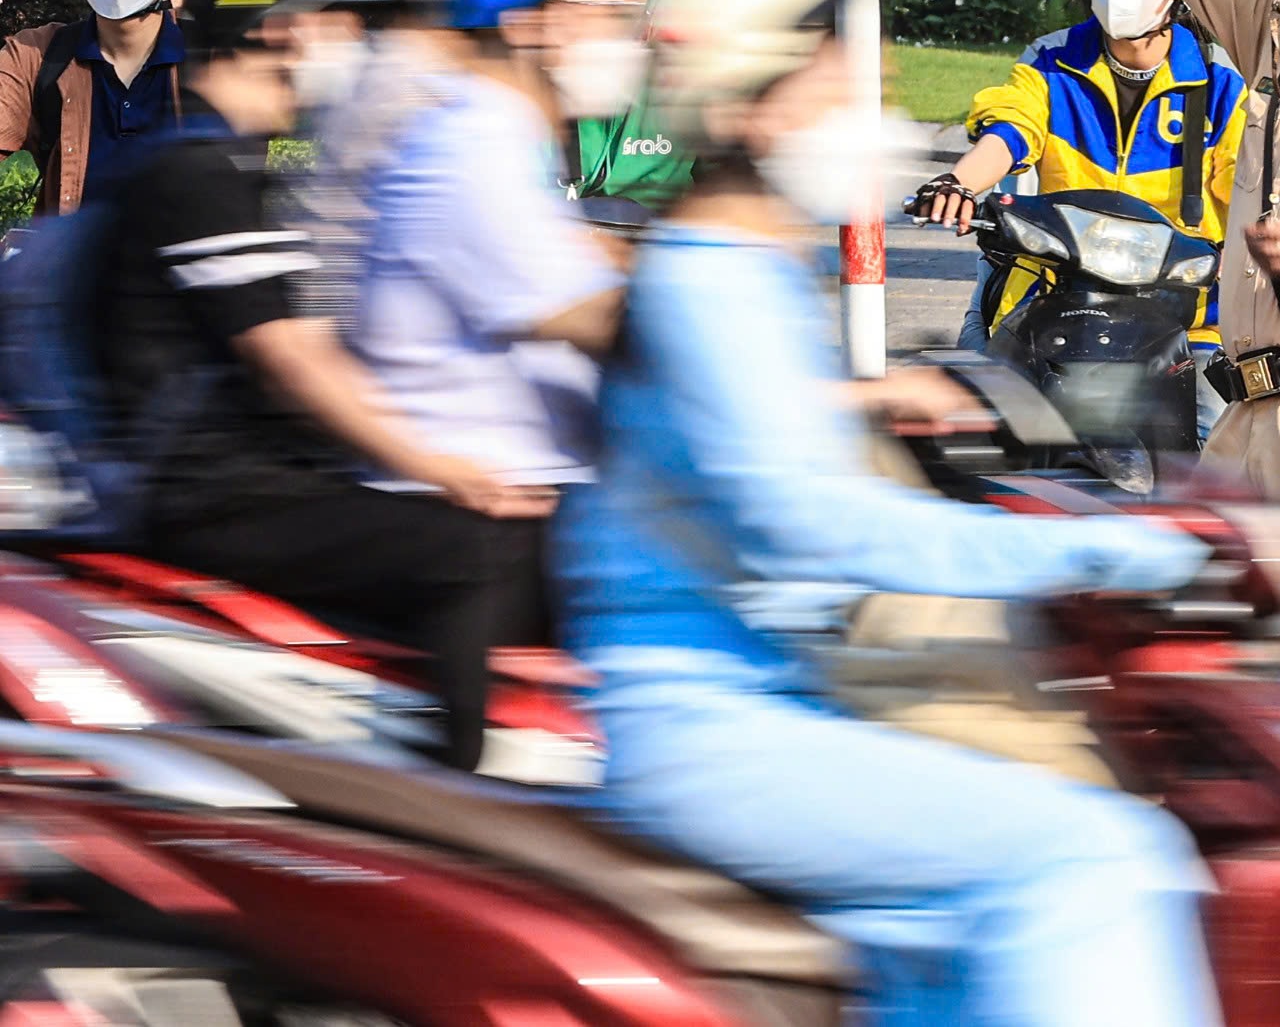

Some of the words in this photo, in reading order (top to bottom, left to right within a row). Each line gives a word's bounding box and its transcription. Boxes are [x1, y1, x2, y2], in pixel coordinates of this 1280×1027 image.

[1157, 96, 1214, 144] b
[622, 133, 673, 156] Grab
[1060, 308, 1111, 319] HONDA
